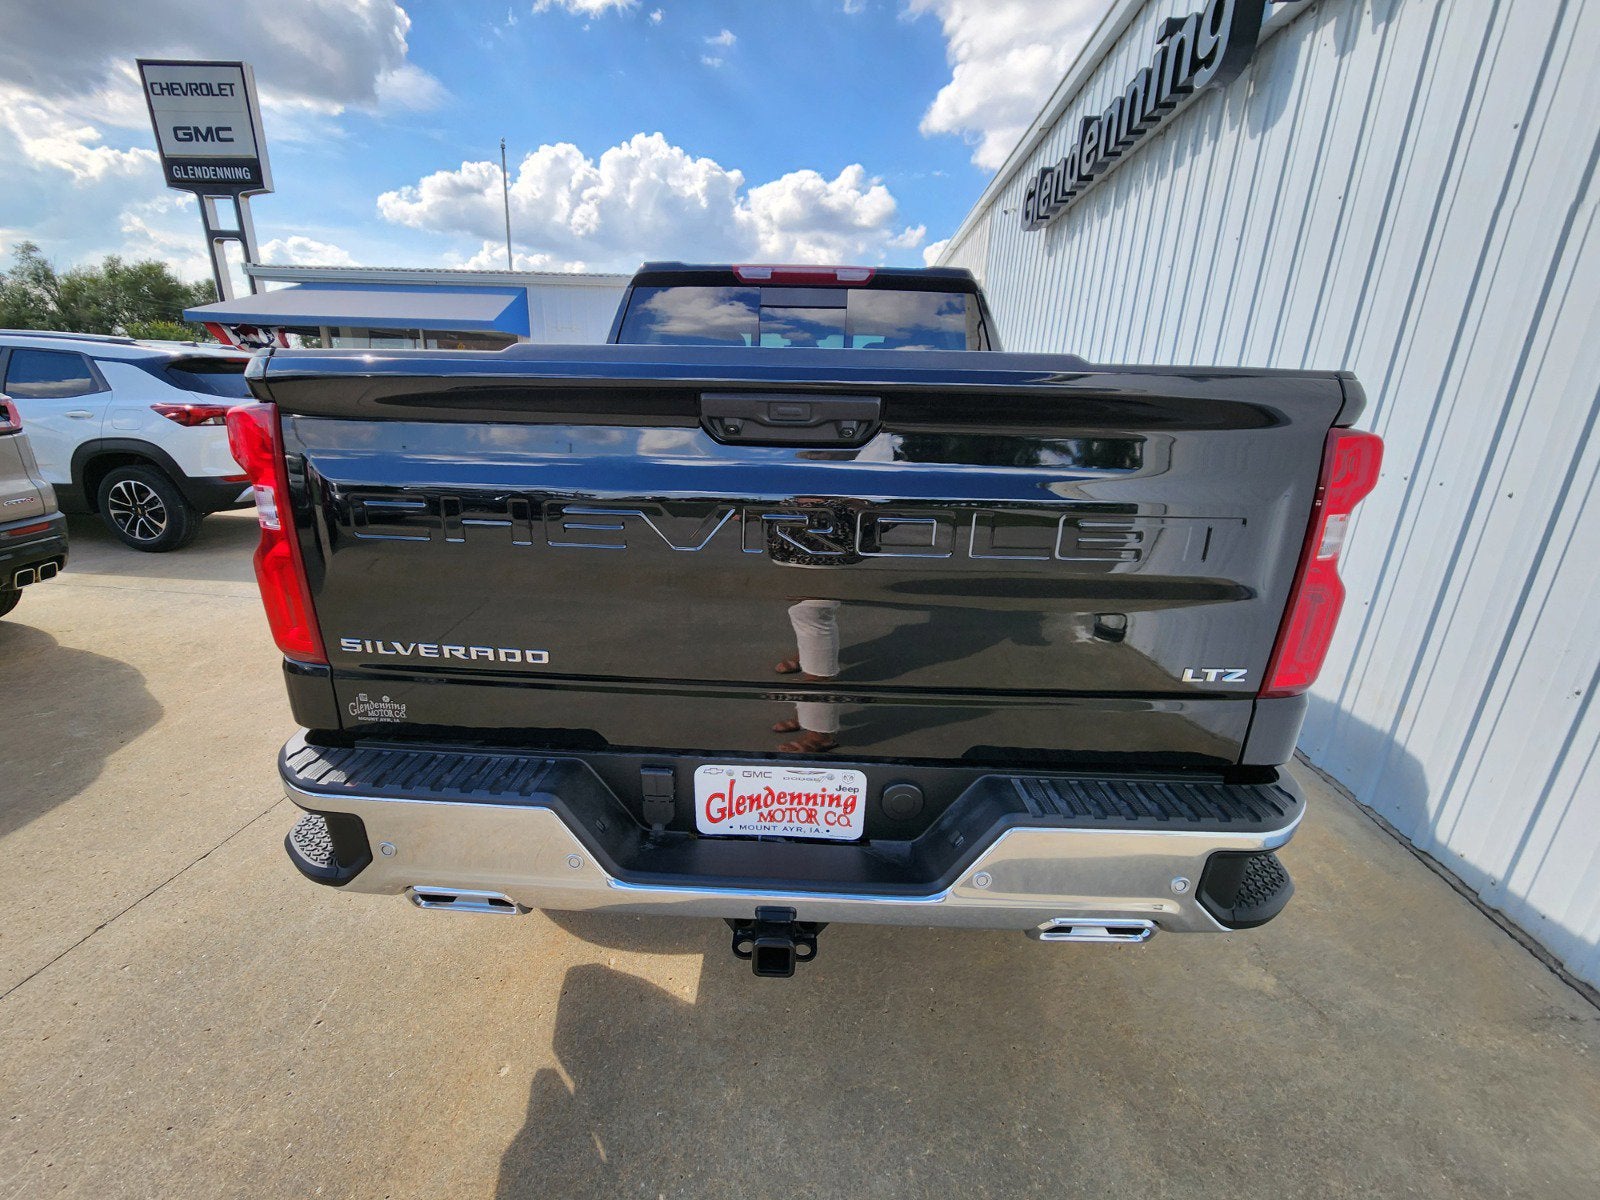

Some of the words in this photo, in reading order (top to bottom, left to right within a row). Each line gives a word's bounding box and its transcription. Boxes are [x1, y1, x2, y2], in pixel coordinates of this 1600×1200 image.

[150, 82, 235, 97] CHEVROLET
[1021, 0, 1236, 231] Glendenning
[172, 126, 235, 142] GMC
[172, 165, 251, 180] GLENDENNING
[347, 493, 1247, 563] CHEVROLET
[340, 637, 550, 664] SILVERADO
[1181, 668, 1248, 682] LTZ
[348, 696, 406, 715] Glendenning
[368, 709, 394, 717] MOTOR
[742, 770, 772, 778] GMC
[835, 785, 859, 794] Jeep
[705, 779, 857, 823] Glendenning
[757, 807, 820, 826] MOTOR
[782, 826, 806, 834] AYR,
